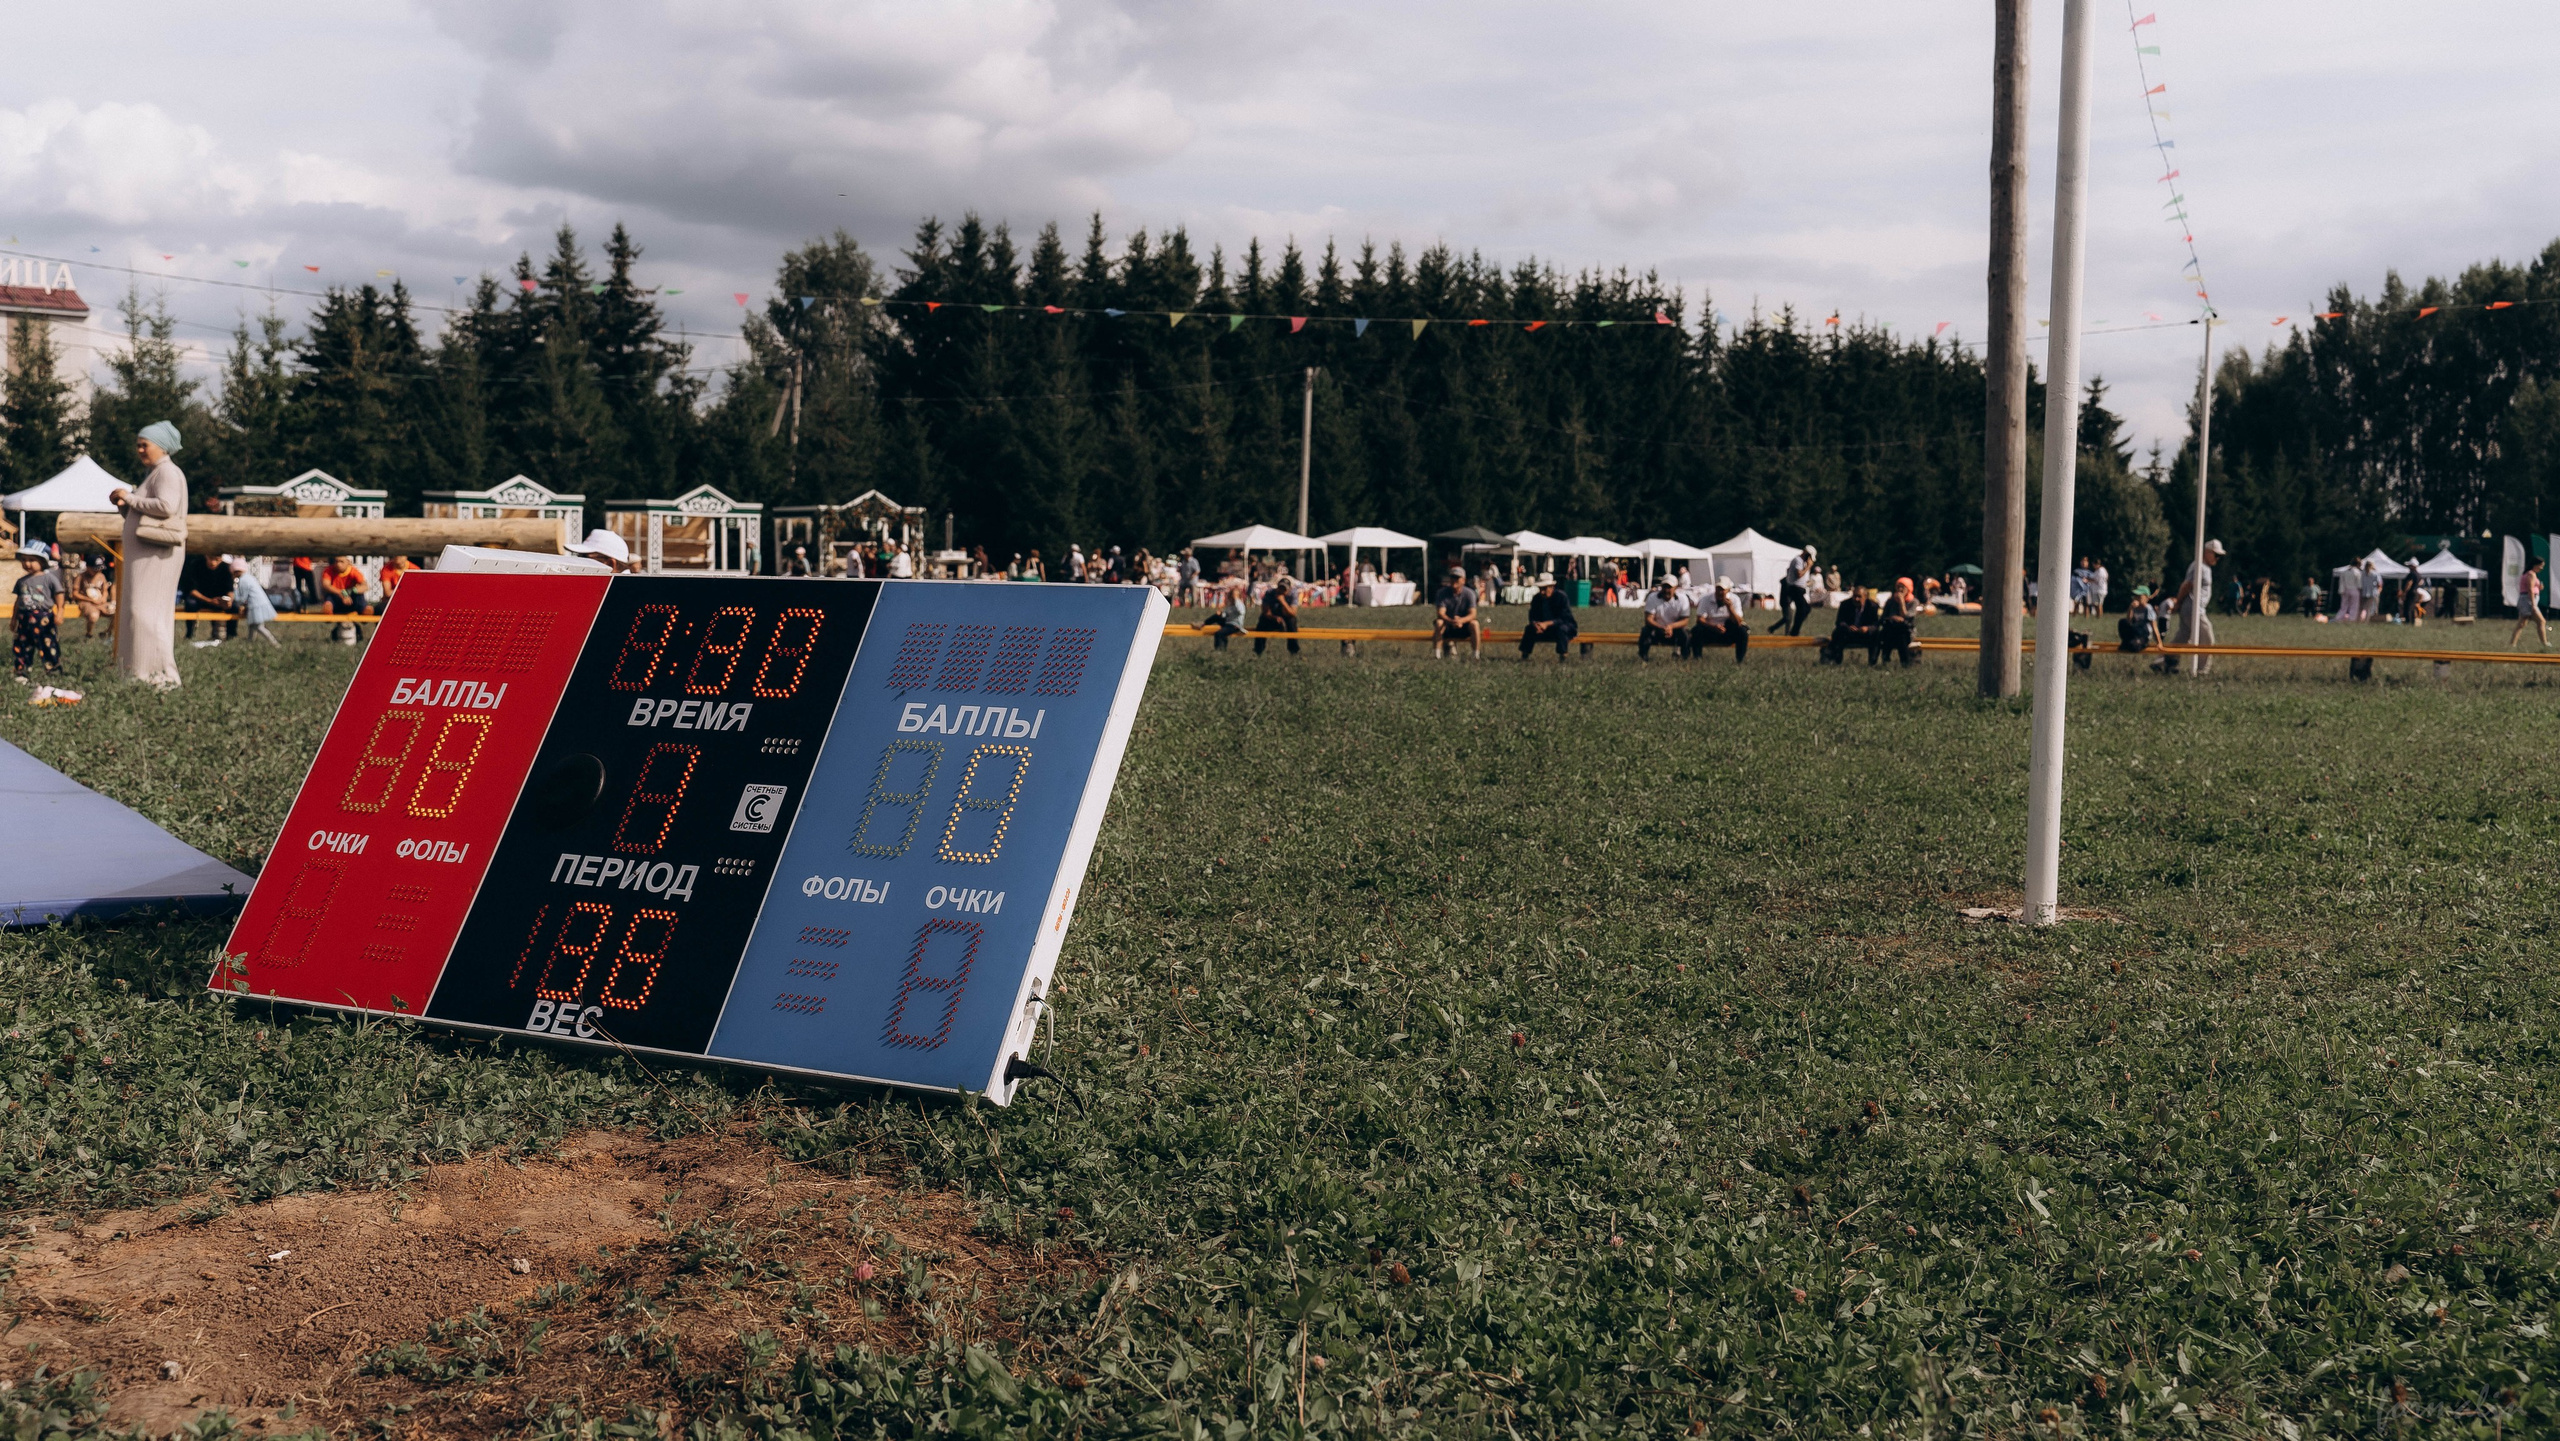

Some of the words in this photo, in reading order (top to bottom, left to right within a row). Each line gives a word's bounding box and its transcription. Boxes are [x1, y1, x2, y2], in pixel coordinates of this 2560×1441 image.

[390, 678, 508, 709] БАЛЛЫ
[627, 697, 753, 731] ВРЕМЯ
[897, 702, 1045, 739] БАЛЛЫ
[746, 785, 785, 795] СЧЕТНЫЕ
[732, 821, 772, 831] СИСТЕМЫ
[308, 829, 370, 856] ОЧКИ
[395, 837, 470, 864] ФОЛЫ
[550, 853, 701, 902] ПЕРИОД
[801, 874, 892, 904] ФОЛЫ
[925, 885, 1006, 915] ОЧКИ
[525, 999, 604, 1038] ВЕС
